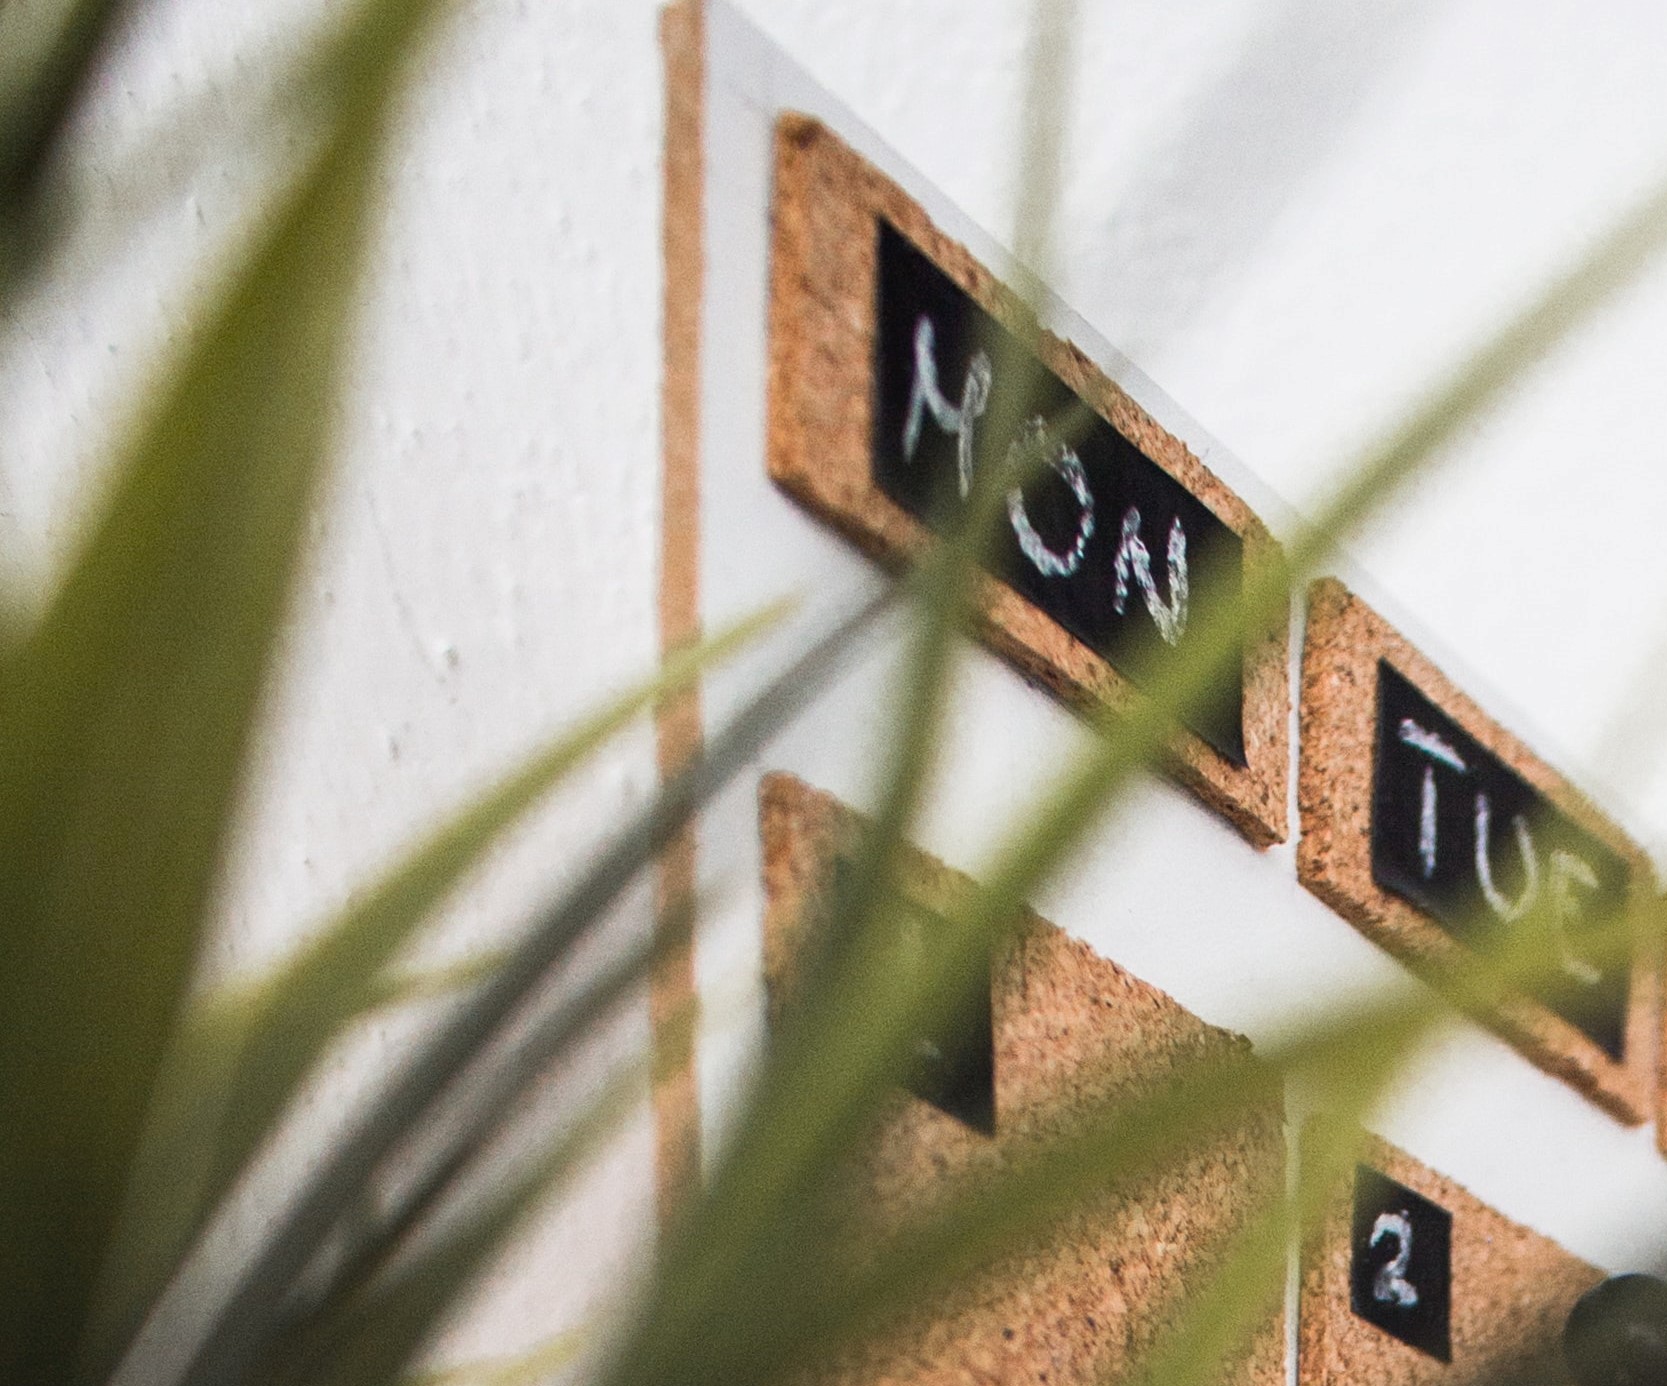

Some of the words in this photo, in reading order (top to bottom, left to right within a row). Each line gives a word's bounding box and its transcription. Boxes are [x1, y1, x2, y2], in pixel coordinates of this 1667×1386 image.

[902, 314, 1189, 648] MON
[1397, 716, 1604, 986] TUE
[1367, 1207, 1419, 1309] 2
